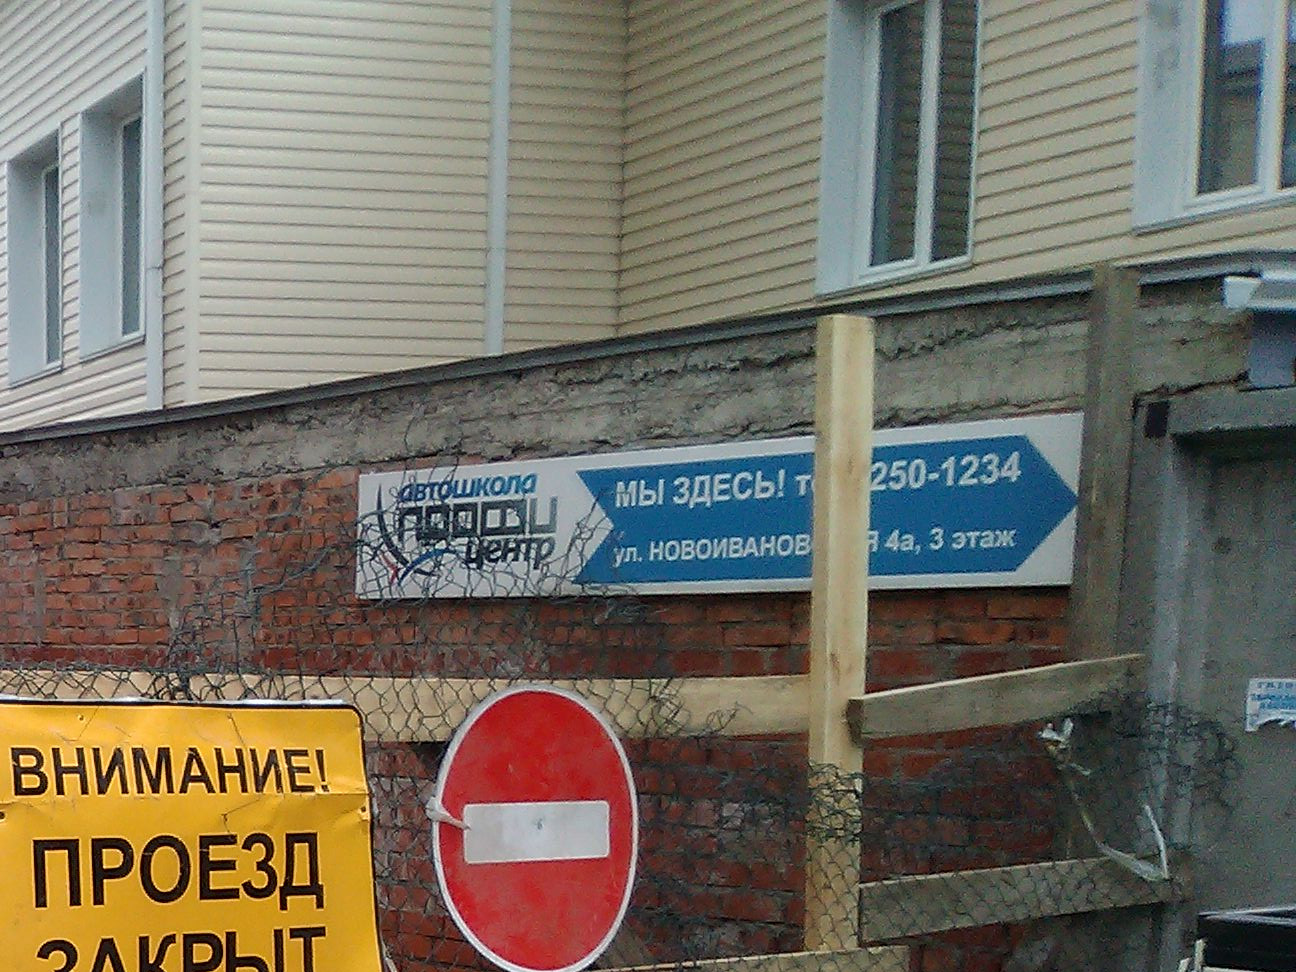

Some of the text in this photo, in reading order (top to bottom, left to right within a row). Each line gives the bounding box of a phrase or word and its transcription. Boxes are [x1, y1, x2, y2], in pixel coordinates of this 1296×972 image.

[616, 479, 665, 508] МЫ
[673, 469, 785, 508] ЗДЕСЬ!
[870, 451, 1021, 491] 250-1234
[613, 527, 1017, 568] ул. НОВОИВАНОВЯ 4а, 3 этаж
[11, 746, 330, 797] ВНИМАНИЕ!
[32, 832, 324, 911] ПРОЕЗД
